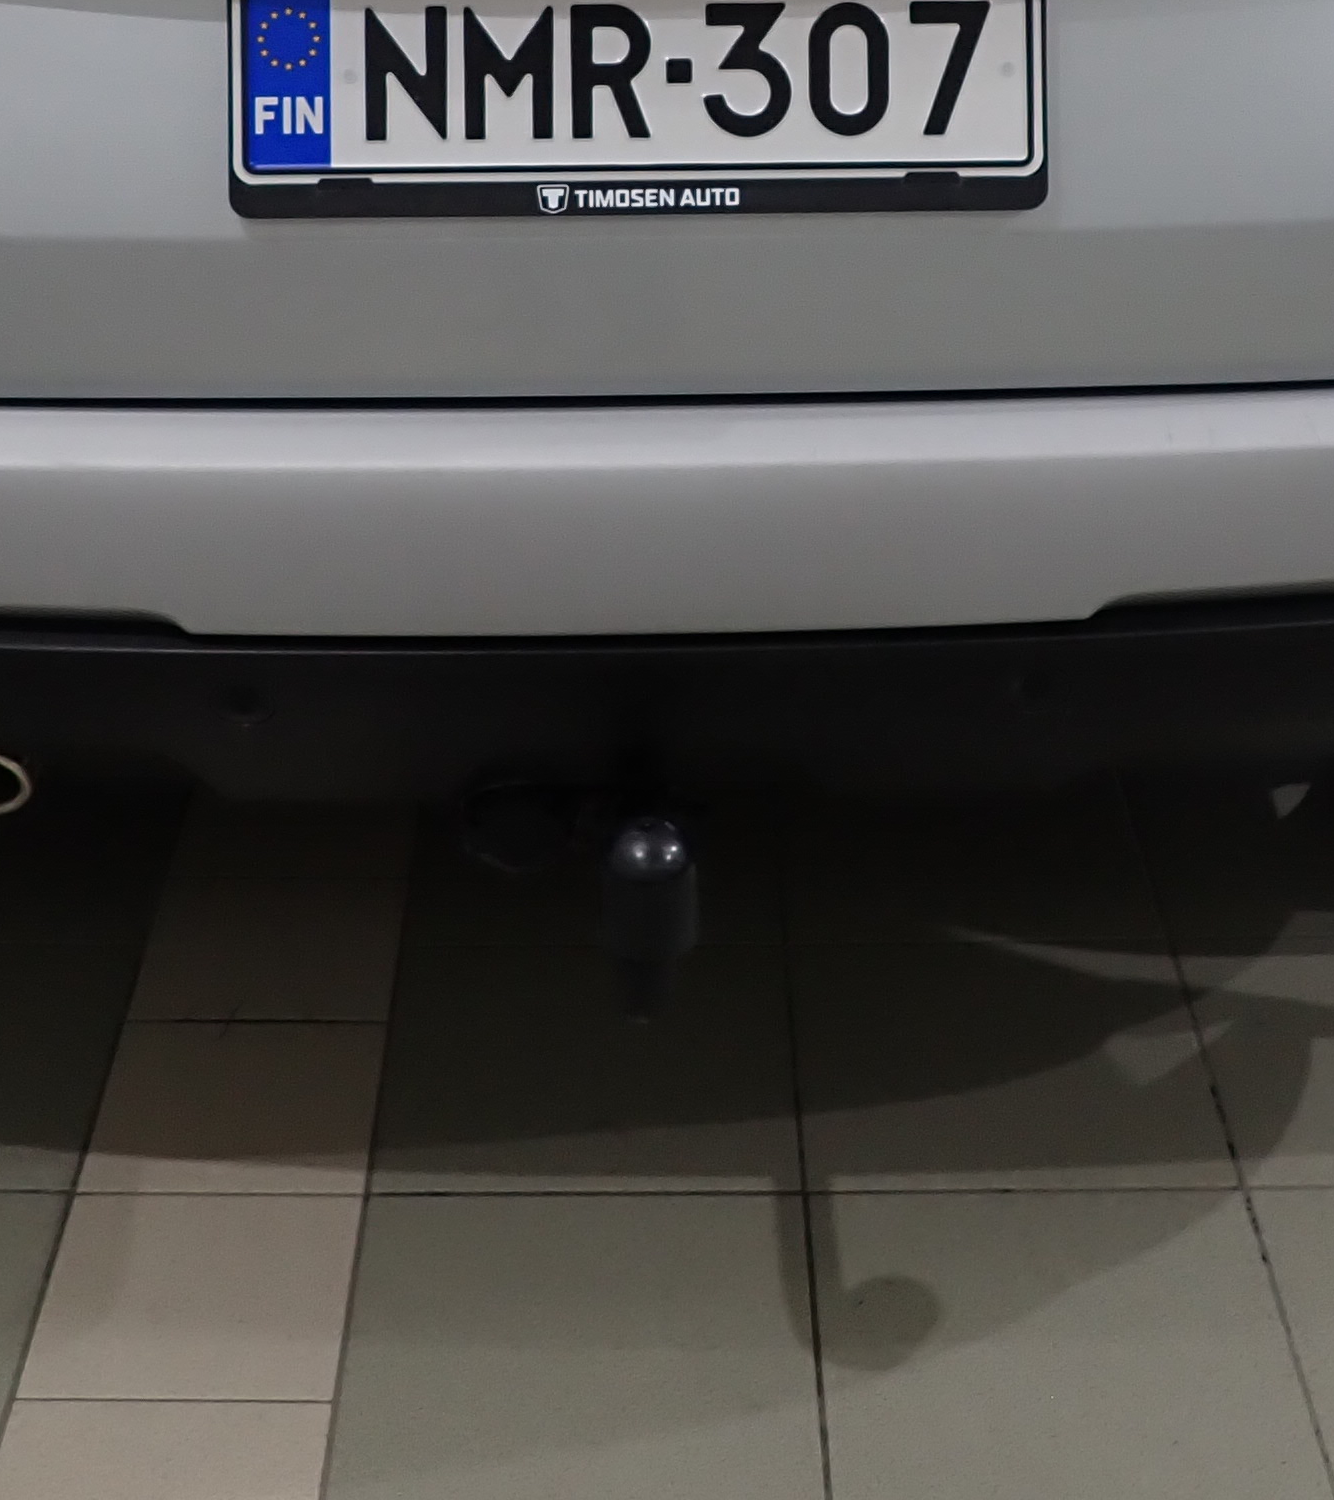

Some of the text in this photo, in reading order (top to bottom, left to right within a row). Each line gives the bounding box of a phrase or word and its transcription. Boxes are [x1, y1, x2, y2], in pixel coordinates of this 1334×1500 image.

[363, 0, 991, 142] NMR-307
[254, 95, 324, 135] FIN
[574, 188, 676, 209] TIMOSEN
[679, 187, 740, 207] AUTO
